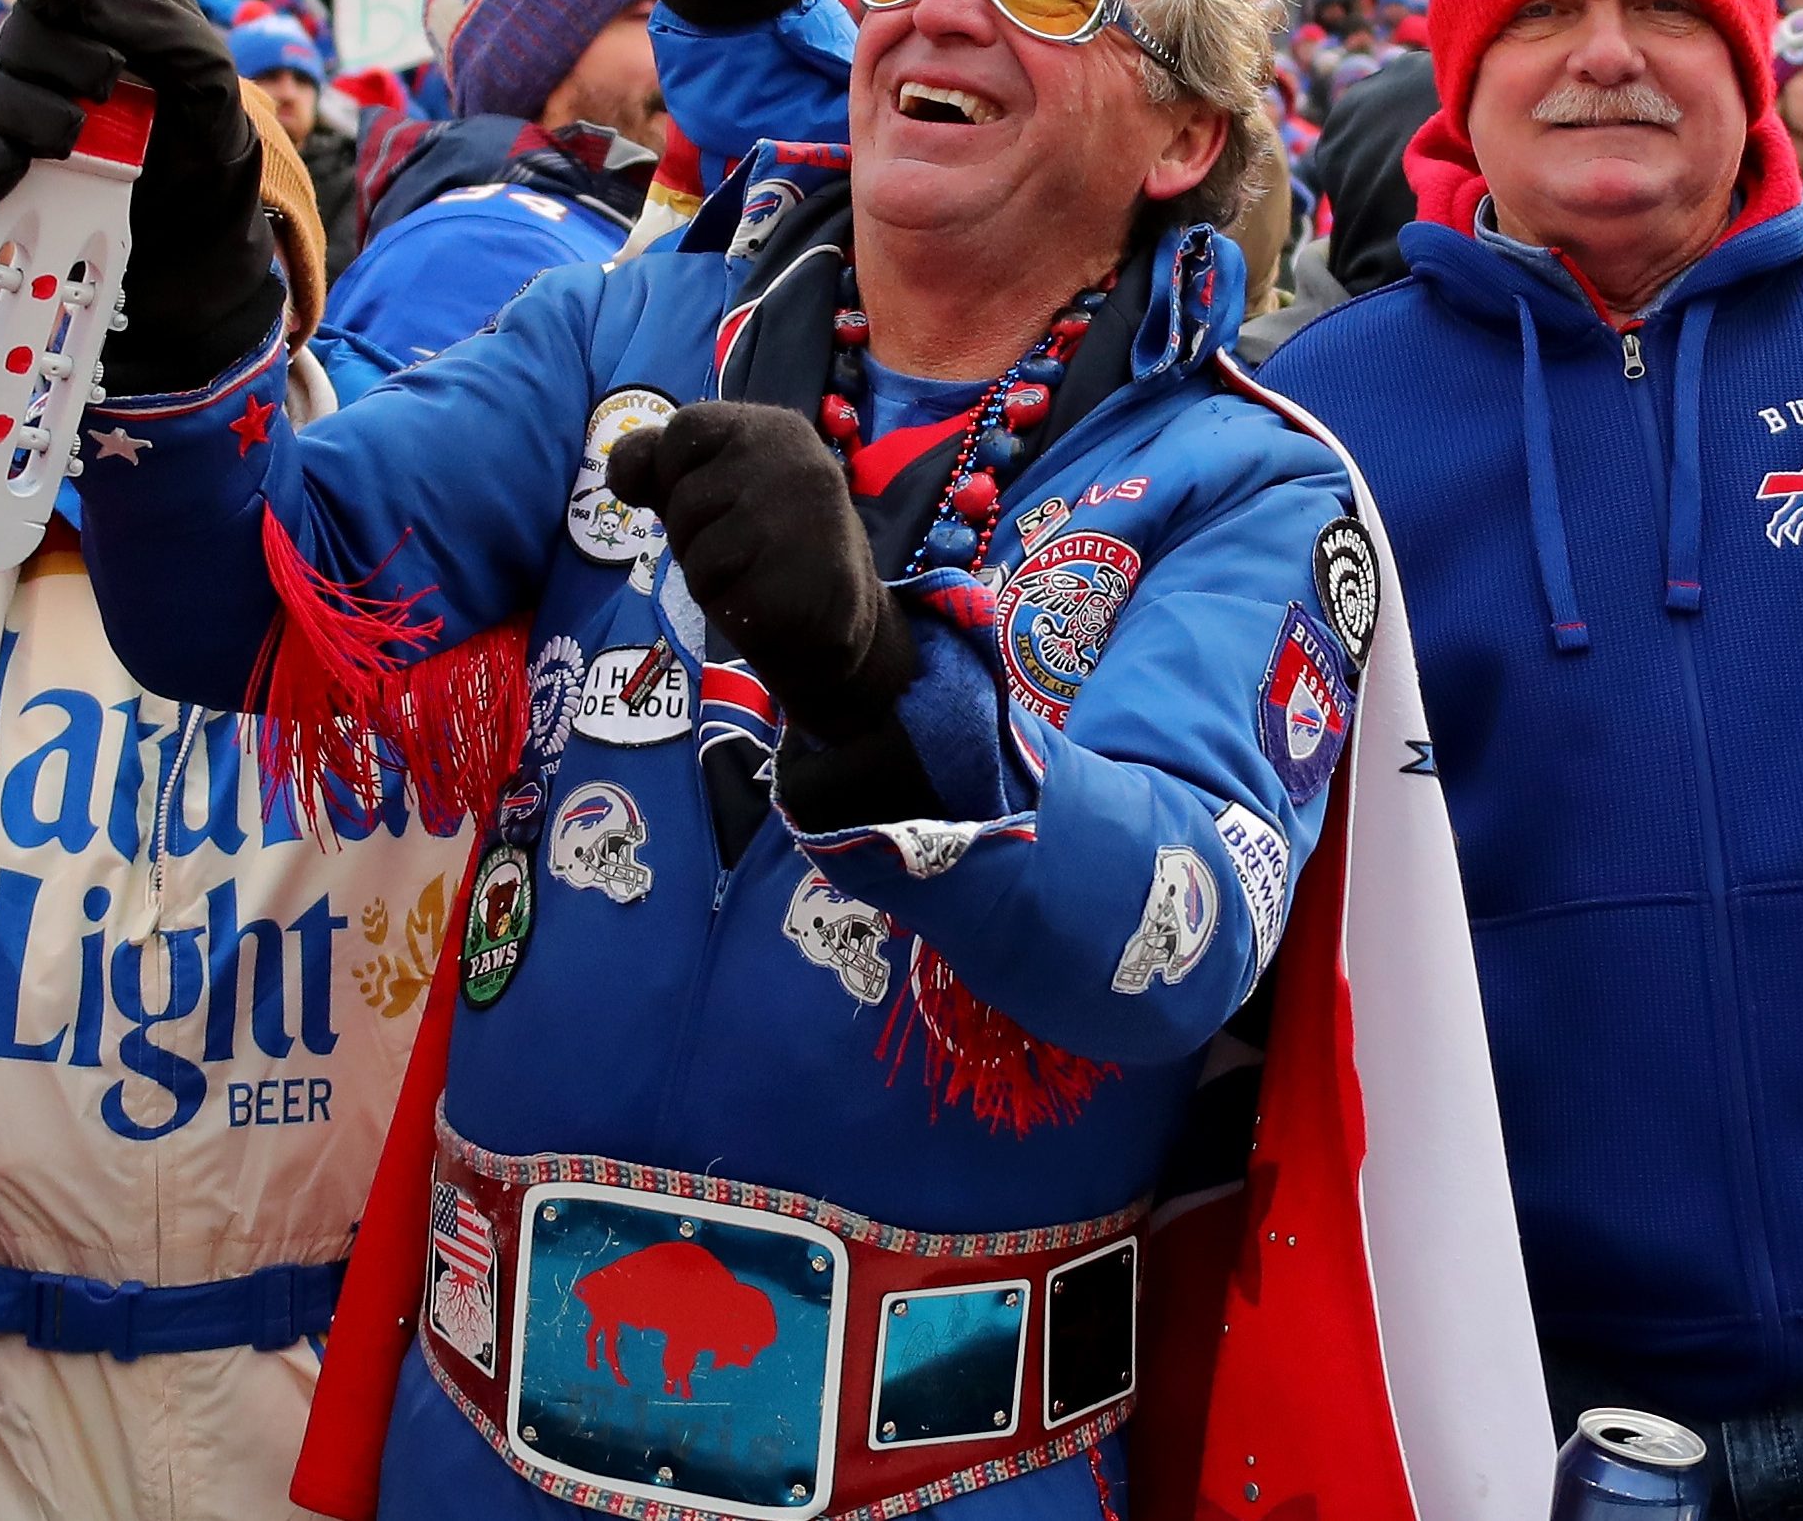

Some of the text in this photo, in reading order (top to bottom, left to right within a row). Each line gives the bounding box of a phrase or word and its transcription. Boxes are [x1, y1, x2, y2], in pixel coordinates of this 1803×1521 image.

[570, 507, 591, 521] 1968
[1038, 539, 1118, 568] PACIFIC
[610, 665, 683, 691] HE
[1290, 621, 1347, 718] BUFFALO
[1298, 664, 1332, 718] 1960
[1255, 828, 1285, 879] BIG
[468, 940, 519, 979] PAWS
[227, 1078, 333, 1129] BEER
